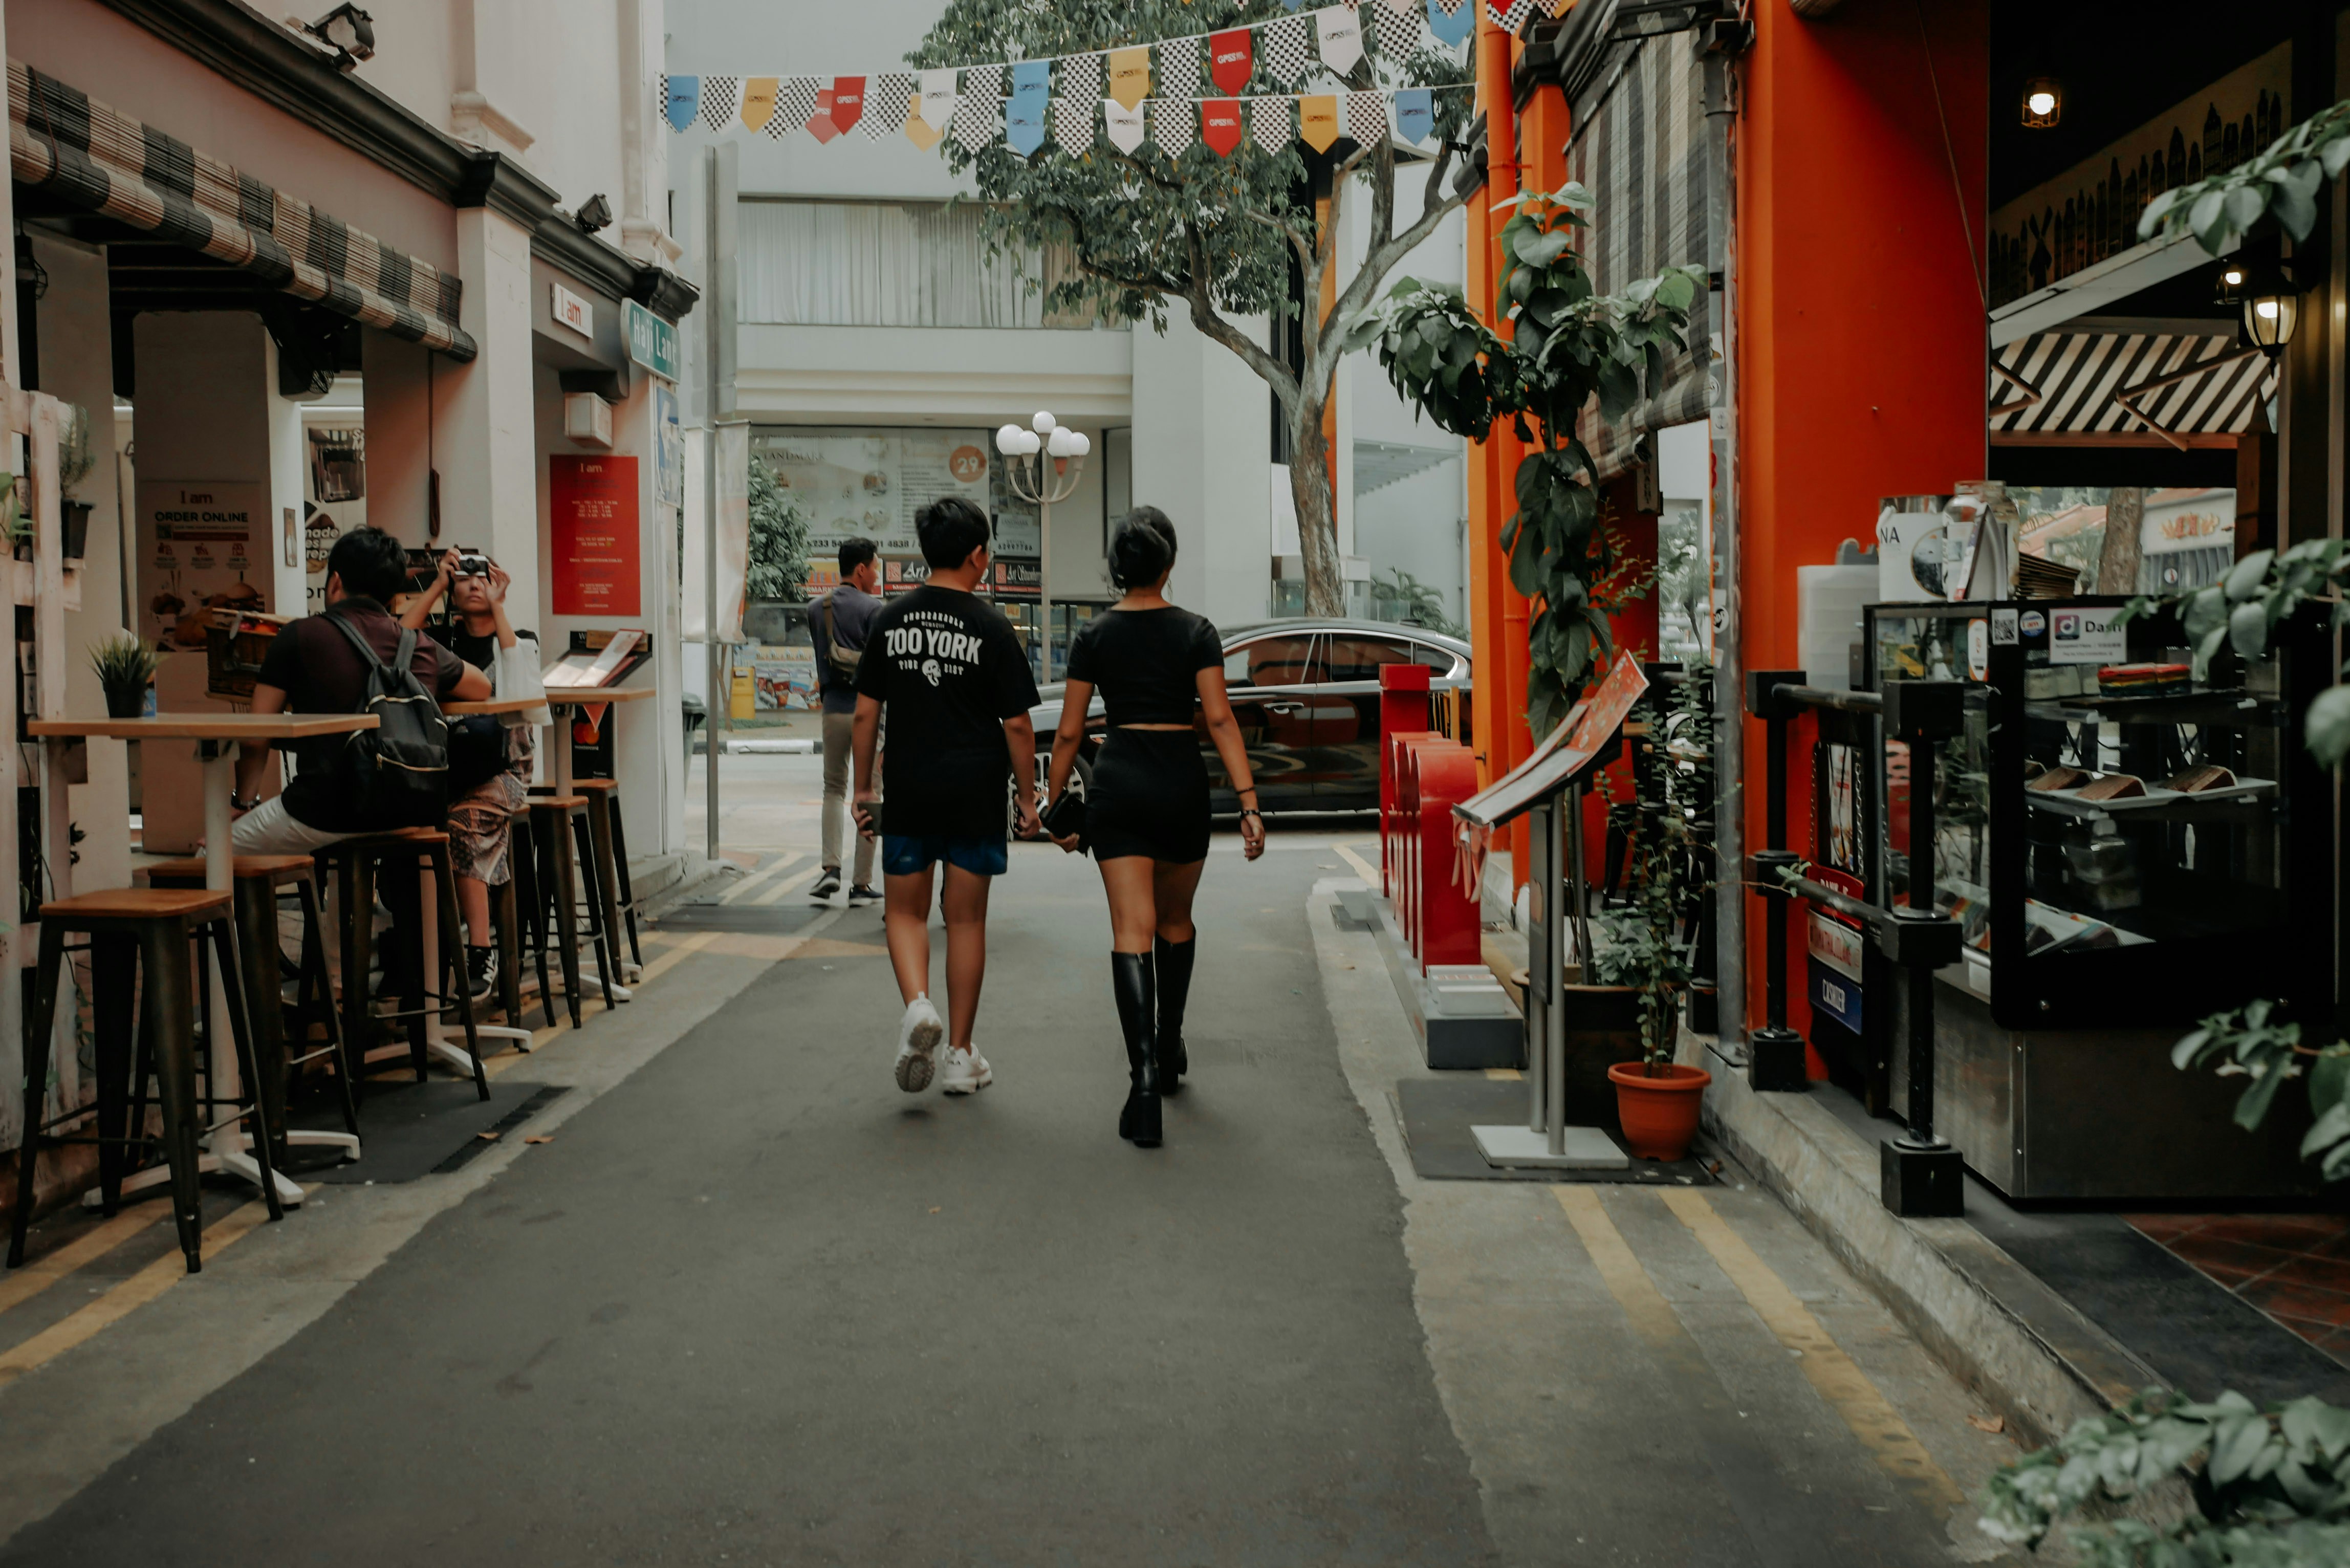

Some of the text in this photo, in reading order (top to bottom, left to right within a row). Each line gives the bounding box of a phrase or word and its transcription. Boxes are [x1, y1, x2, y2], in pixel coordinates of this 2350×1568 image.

[567, 300, 581, 327] am
[634, 310, 677, 365] Haji Lane
[586, 465, 603, 473] am
[190, 493, 213, 504] am
[155, 512, 249, 523] ORDER ONLINE
[885, 627, 983, 665] ZOO YORK
